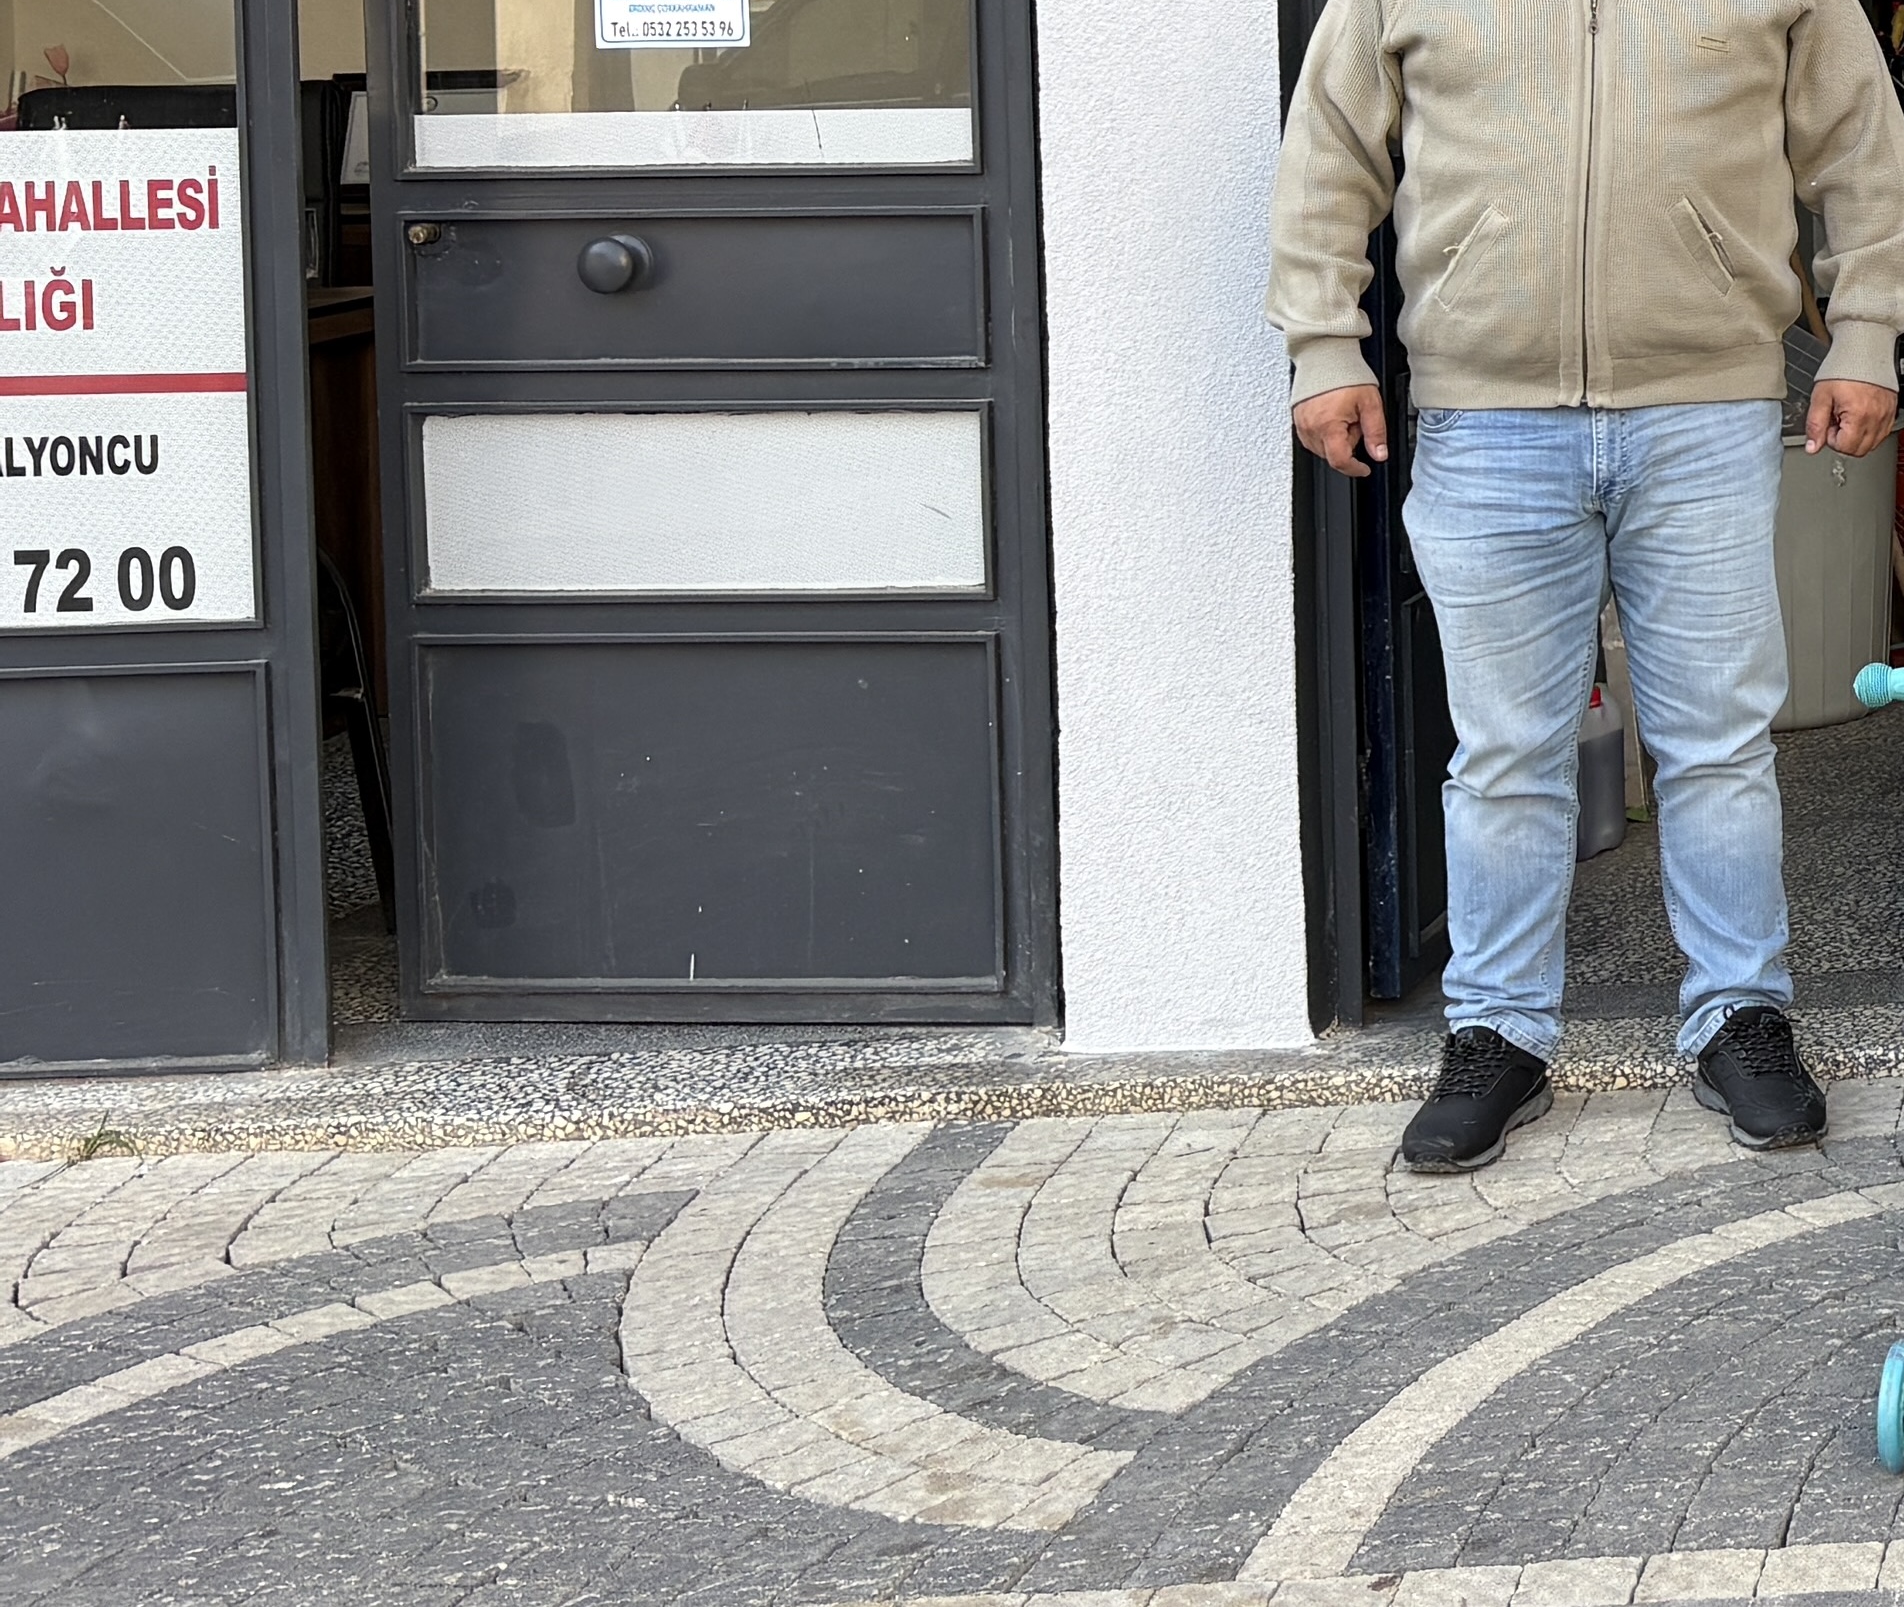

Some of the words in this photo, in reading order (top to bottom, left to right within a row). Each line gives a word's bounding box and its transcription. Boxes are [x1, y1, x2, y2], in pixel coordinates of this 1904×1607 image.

[642, 21, 672, 37] 0532
[676, 21, 697, 37] 253
[701, 21, 716, 37] 53
[719, 21, 734, 37] 96
[0, 434, 159, 477] LYONCU
[14, 549, 93, 613] 72
[118, 546, 195, 612] 00
